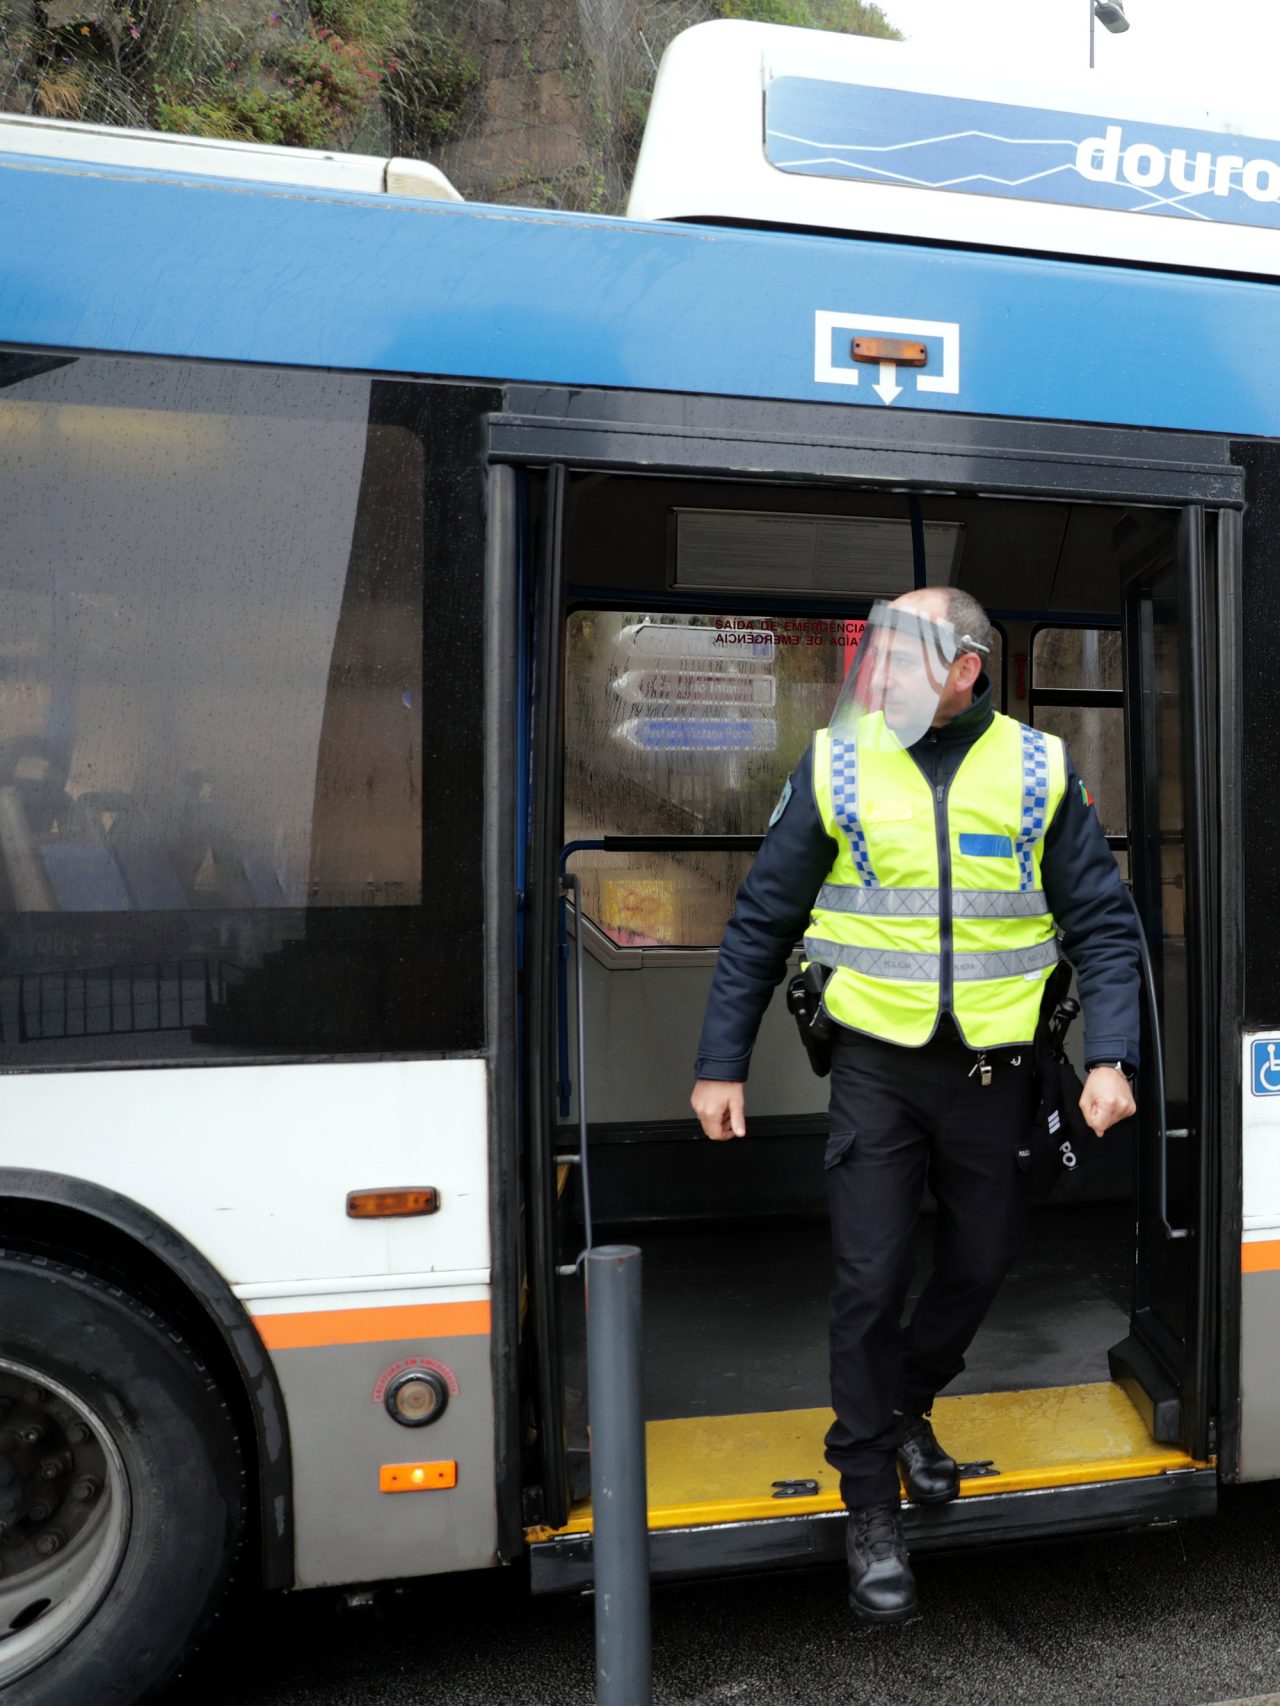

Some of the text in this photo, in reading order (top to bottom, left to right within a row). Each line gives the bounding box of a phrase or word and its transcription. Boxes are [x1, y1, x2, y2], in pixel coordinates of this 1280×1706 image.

[715, 618, 865, 633] SAÍDA DE EMERGÊNCIA
